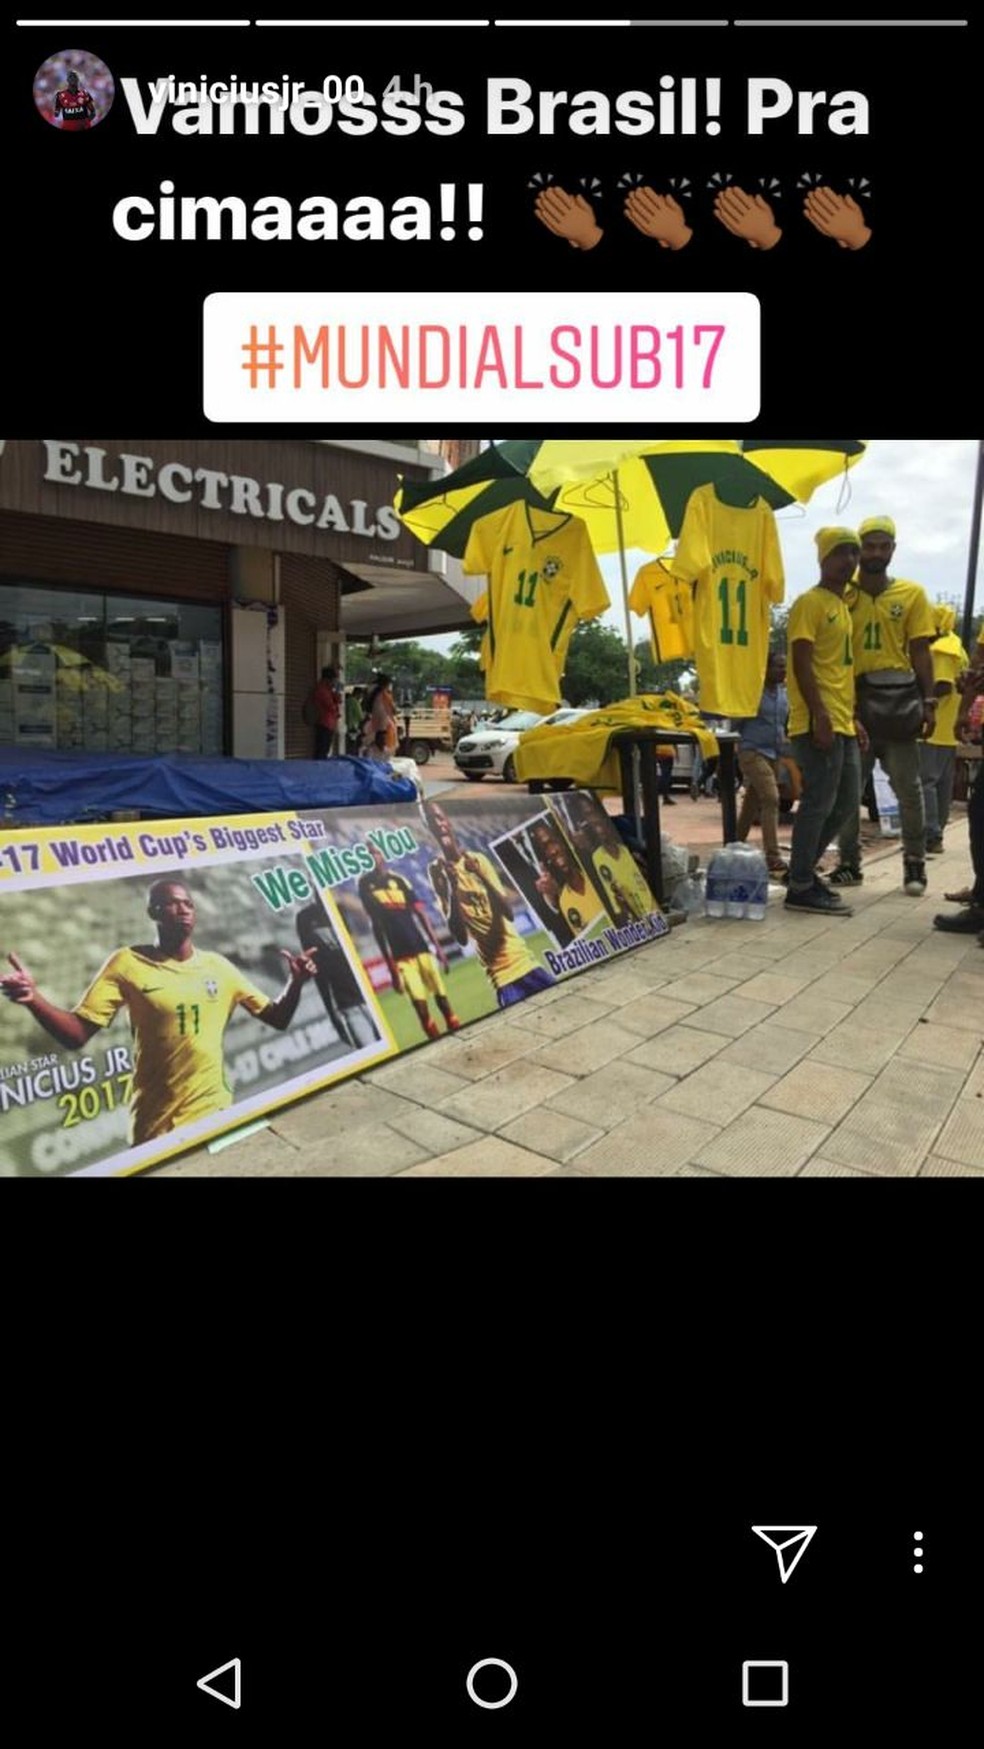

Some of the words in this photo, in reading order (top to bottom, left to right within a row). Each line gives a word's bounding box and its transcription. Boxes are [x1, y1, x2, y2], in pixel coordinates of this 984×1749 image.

[43, 440, 400, 540] ELECTRICALS
[514, 569, 538, 607] 11
[718, 577, 748, 646] 11
[863, 622, 882, 650] 11
[50, 836, 134, 868] World
[139, 831, 208, 859] Cup's
[209, 823, 286, 851] Biggest
[287, 820, 324, 840] Star
[253, 867, 310, 910] We
[306, 844, 375, 888] Miss
[369, 827, 417, 860] You
[544, 938, 608, 976] Brazilian
[30, 1053, 58, 1071] STAR
[104, 1047, 132, 1077] JR
[59, 1073, 133, 1128] 2017
